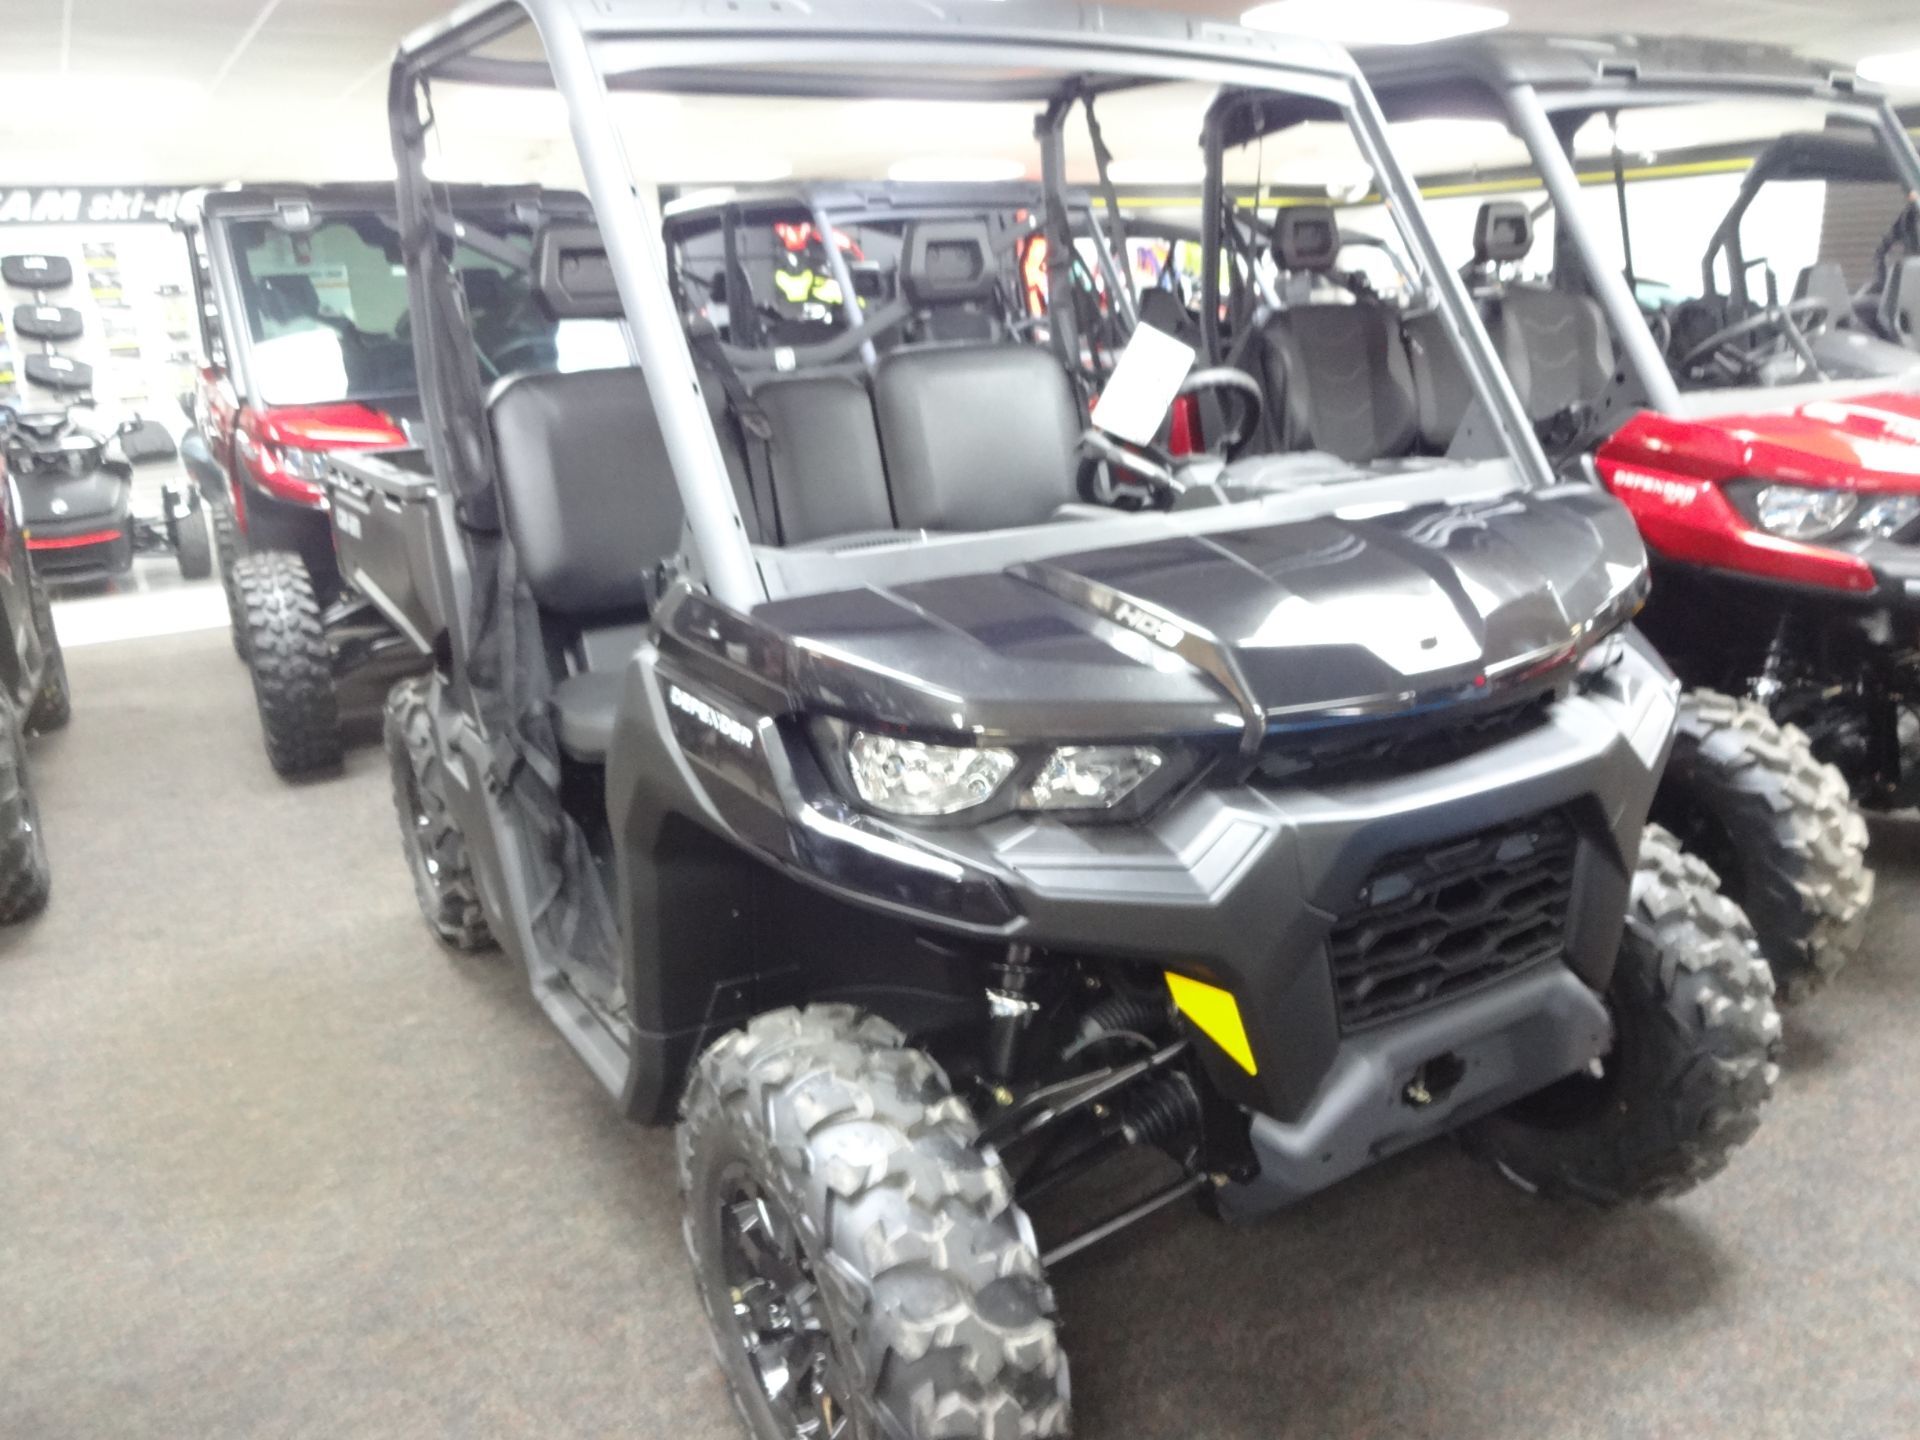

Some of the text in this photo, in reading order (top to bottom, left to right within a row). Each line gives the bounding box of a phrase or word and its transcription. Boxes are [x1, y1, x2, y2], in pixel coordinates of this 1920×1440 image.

[0, 189, 82, 222] AM
[1613, 469, 1697, 505] DEFENDER
[668, 684, 754, 750] DEFENDER
